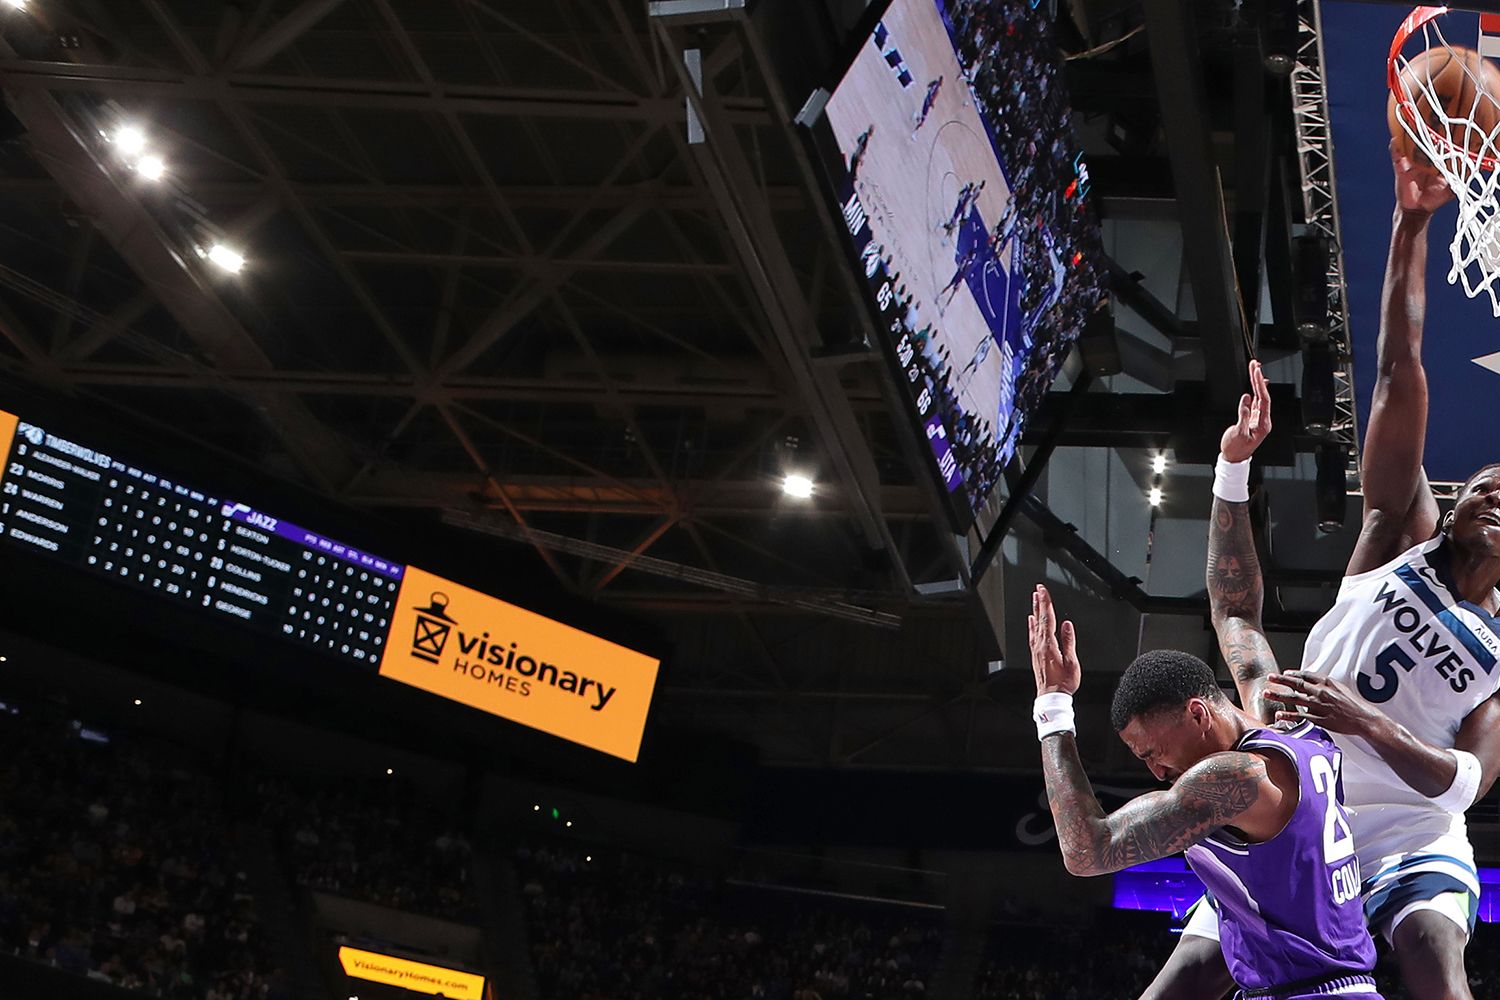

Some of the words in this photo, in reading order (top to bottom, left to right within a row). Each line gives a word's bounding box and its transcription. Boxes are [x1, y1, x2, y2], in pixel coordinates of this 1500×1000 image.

[843, 193, 867, 236] MIN
[246, 511, 278, 532] JAZZ
[1373, 581, 1475, 693] WOLVES
[453, 658, 532, 697] HOMES
[457, 631, 616, 711] visionary
[1357, 643, 1417, 703] 5
[354, 960, 468, 991] VisionaryHomes.com
